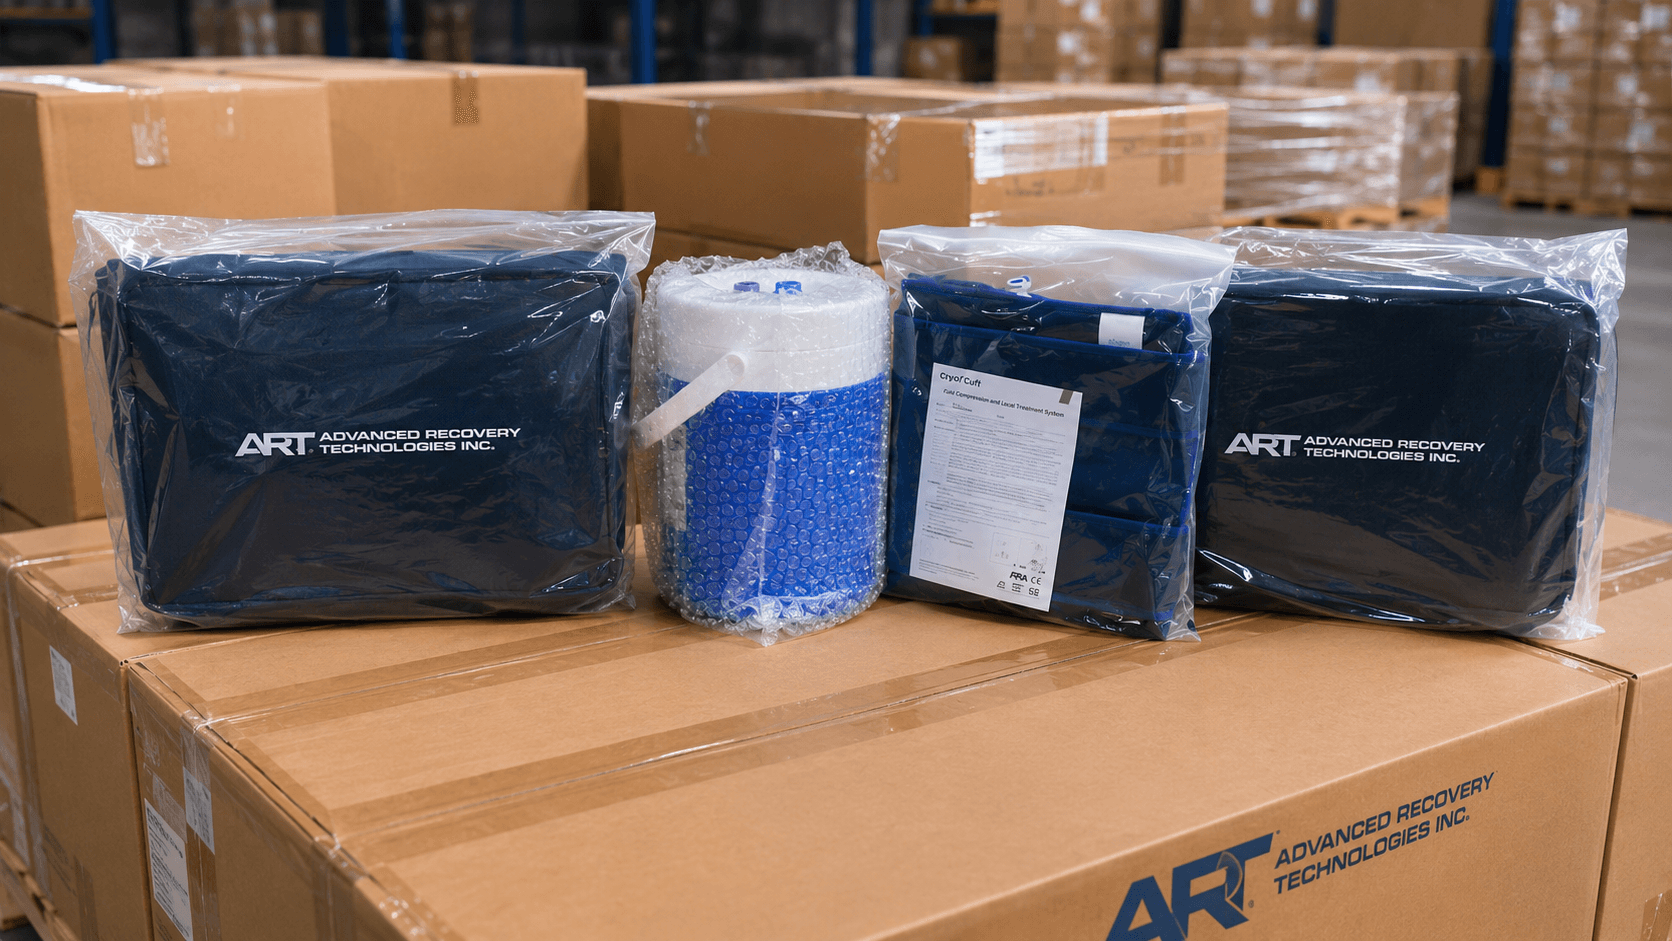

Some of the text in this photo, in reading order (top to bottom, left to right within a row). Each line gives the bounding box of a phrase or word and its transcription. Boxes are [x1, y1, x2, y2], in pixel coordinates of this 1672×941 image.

[319, 427, 521, 442] ADVANCED RECOVERY
[319, 440, 495, 454] TECHNOLOGIES INC.
[1303, 436, 1486, 452] ADVANCED RECOVERY
[1303, 448, 1461, 463] TECHNOLOGIES INC.
[1274, 771, 1495, 869] ADVANCED RECOVERY
[1273, 820, 1431, 894] TECHNOLOGIES
